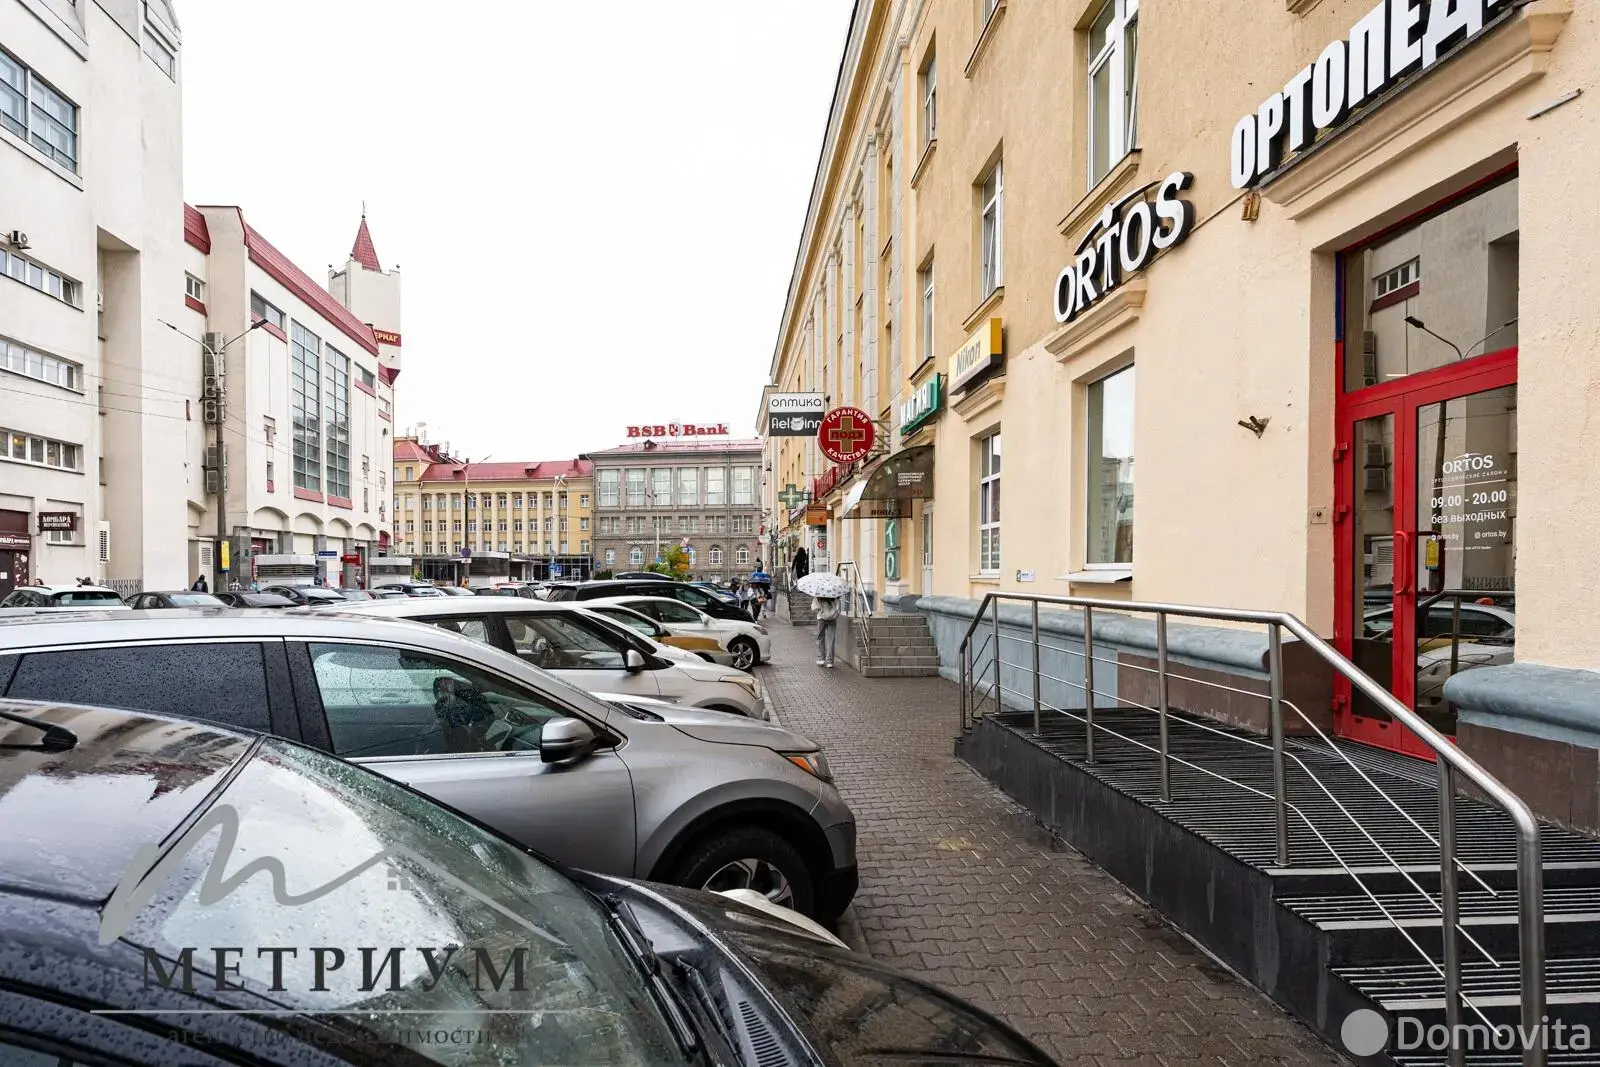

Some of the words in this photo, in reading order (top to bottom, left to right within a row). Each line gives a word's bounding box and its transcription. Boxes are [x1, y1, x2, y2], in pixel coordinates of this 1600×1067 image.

[1231, 0, 1494, 190] ОРТОПЕД
[1053, 171, 1192, 324] ORTOS
[956, 339, 981, 377] Nikon
[826, 409, 869, 425] ГАРАНТИЯ
[627, 425, 667, 438] BSB
[682, 423, 730, 436] Bank
[827, 447, 867, 461] КАЧЕСТВА
[1442, 455, 1494, 474] ORTOS
[1431, 495, 1462, 509] 09.00
[1472, 490, 1507, 505] 20.00
[1431, 514, 1448, 524] без
[1450, 511, 1506, 523] выходных
[1481, 530, 1507, 539] ortos.by
